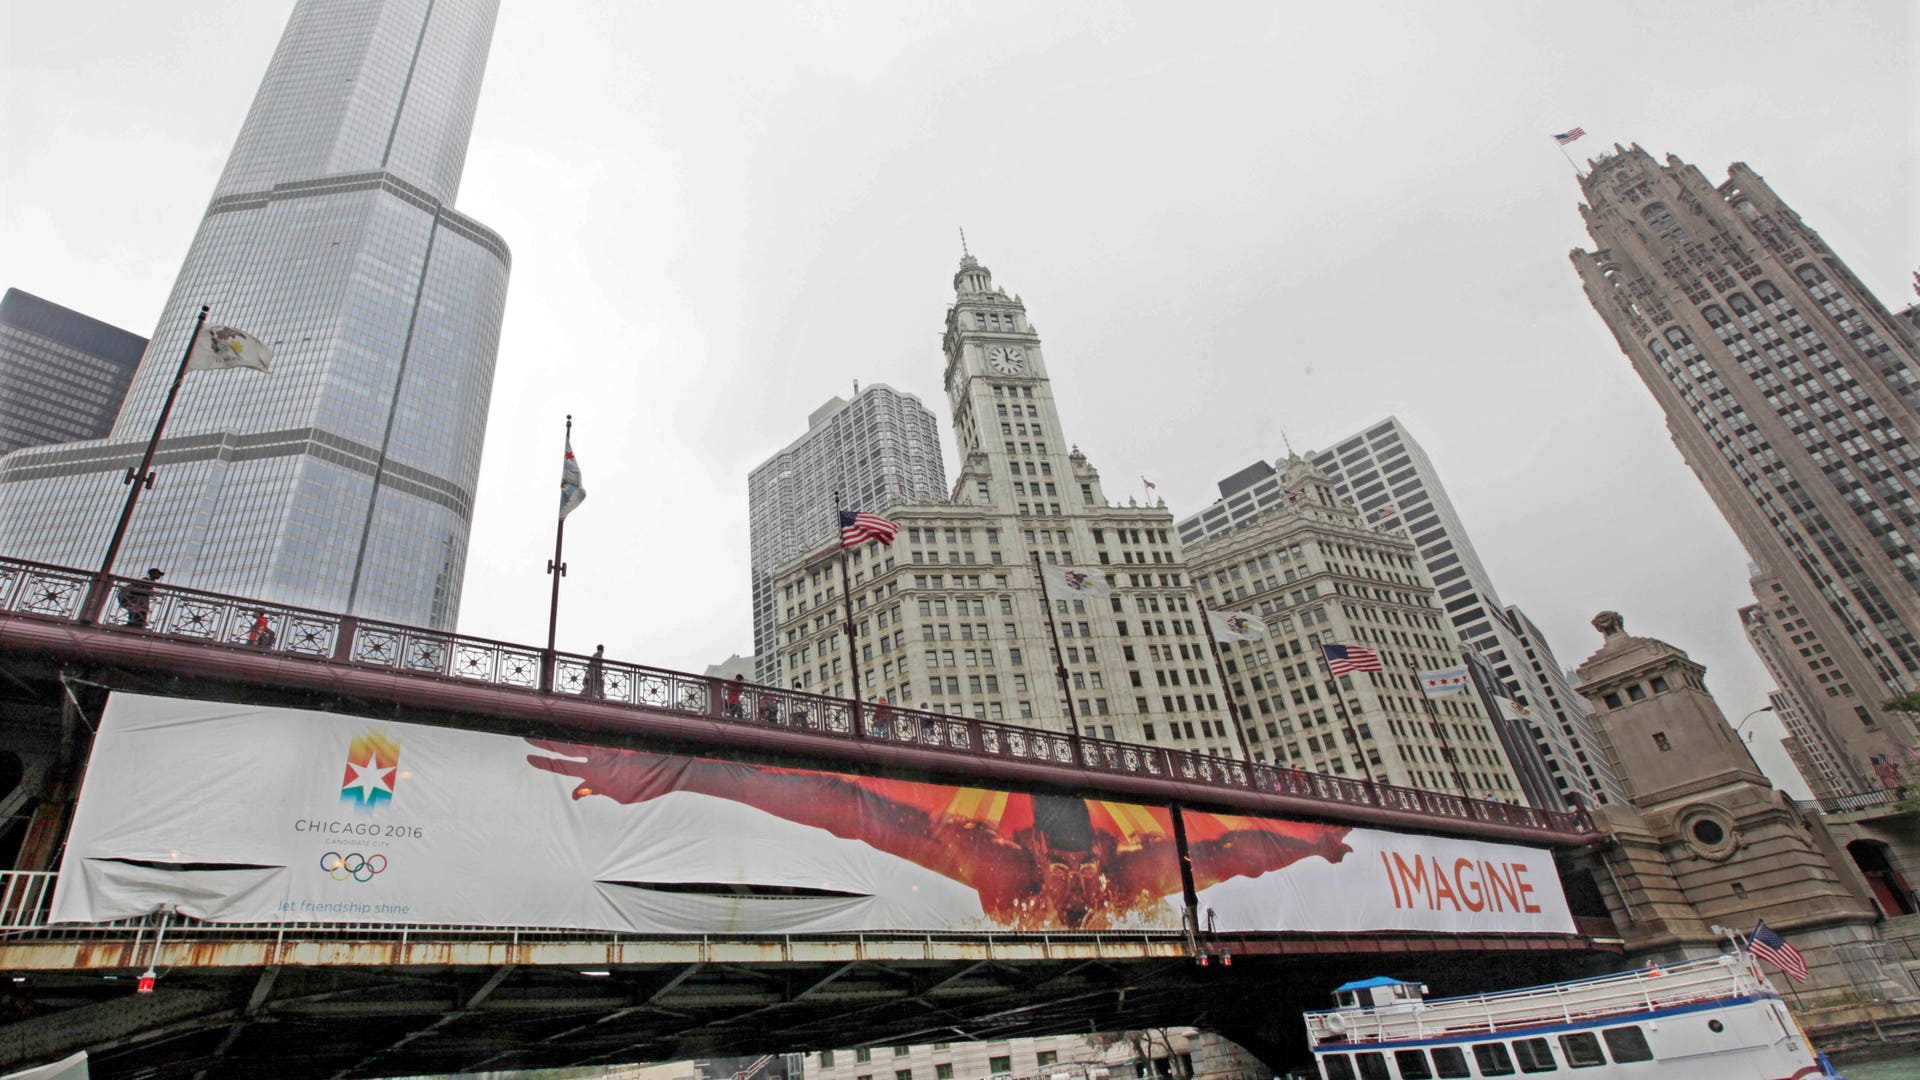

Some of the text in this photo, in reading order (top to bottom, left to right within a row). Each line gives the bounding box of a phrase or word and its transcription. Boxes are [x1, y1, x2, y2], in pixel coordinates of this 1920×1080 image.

[295, 819, 423, 839] CHICAGO 2016
[325, 838, 370, 847] CANDIDATE
[1381, 851, 1541, 913] IMAGINE
[279, 900, 410, 914] let friendship shine
